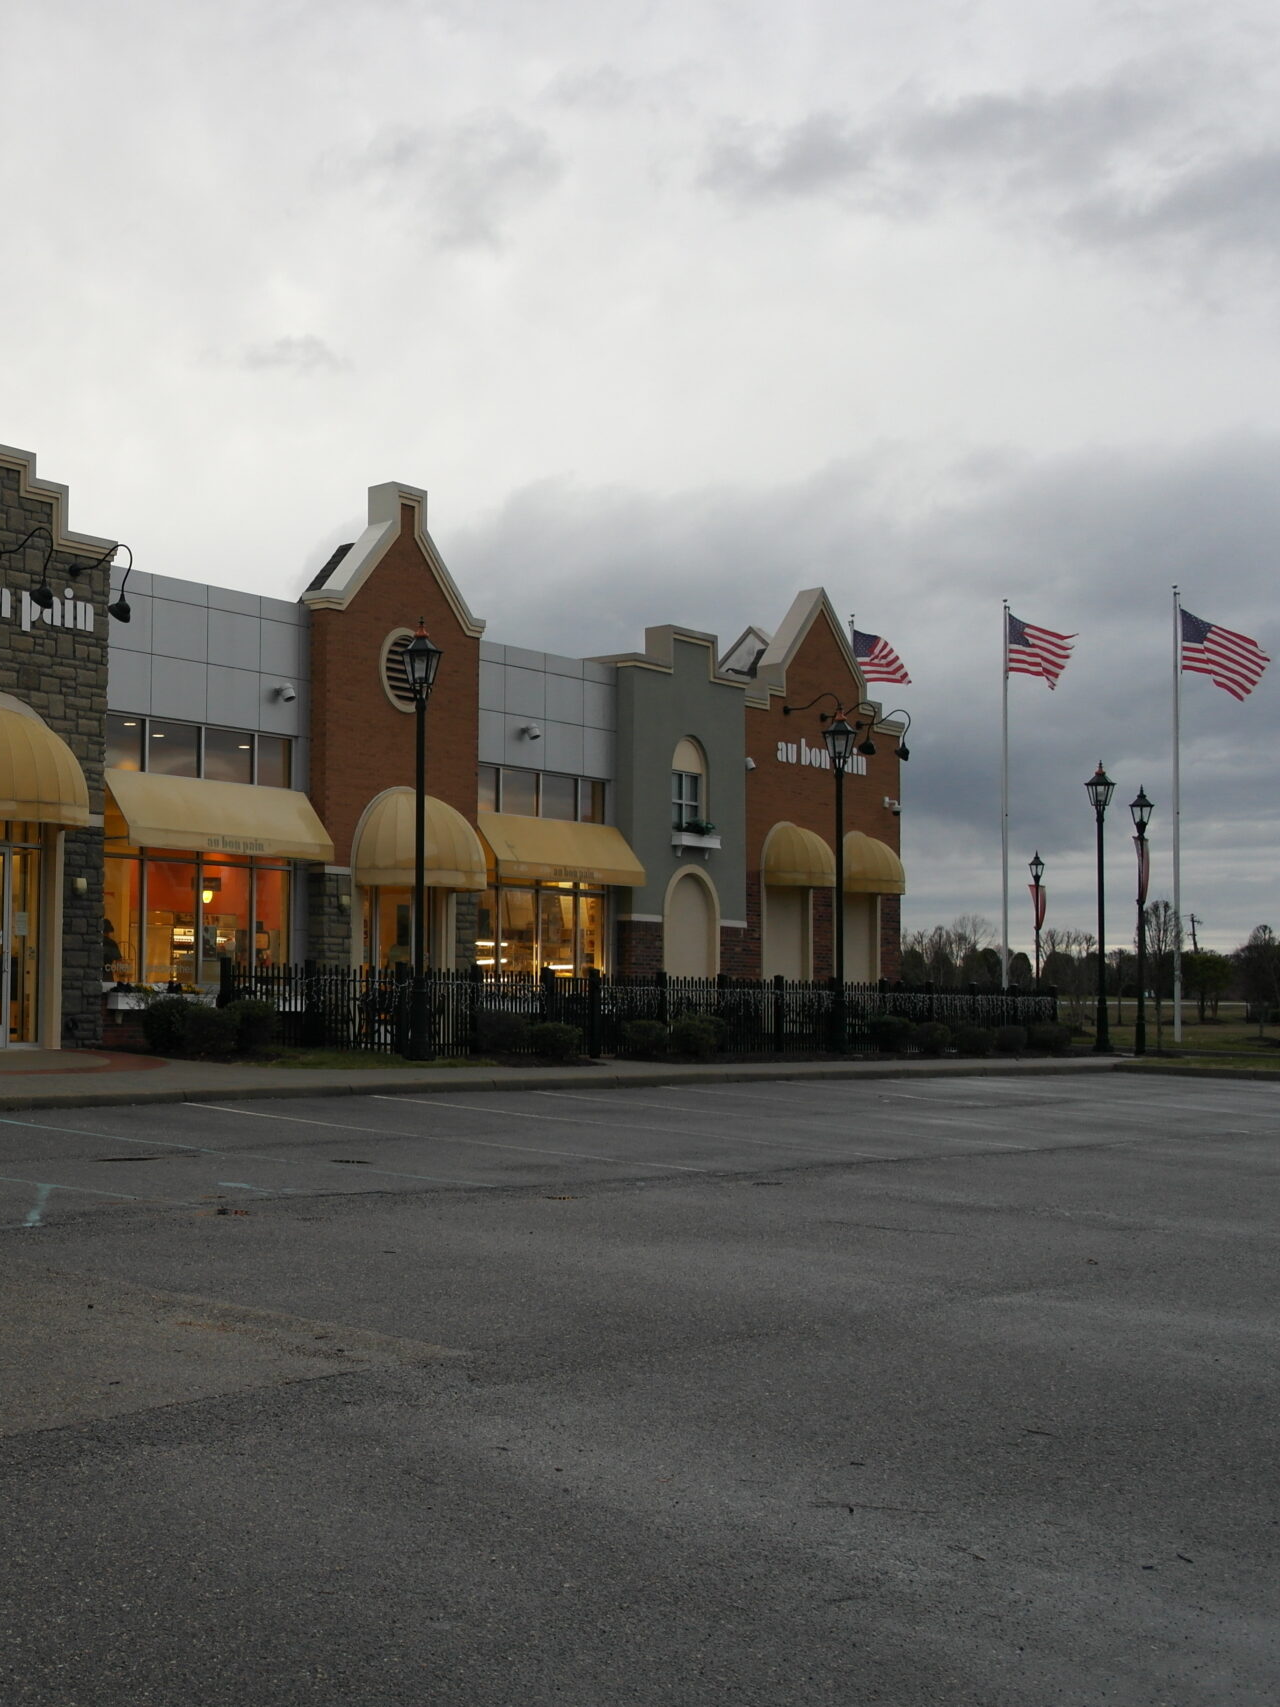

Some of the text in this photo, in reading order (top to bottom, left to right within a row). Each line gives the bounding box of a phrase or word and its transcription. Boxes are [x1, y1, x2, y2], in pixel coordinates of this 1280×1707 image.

[777, 738, 867, 776] au bon ain
